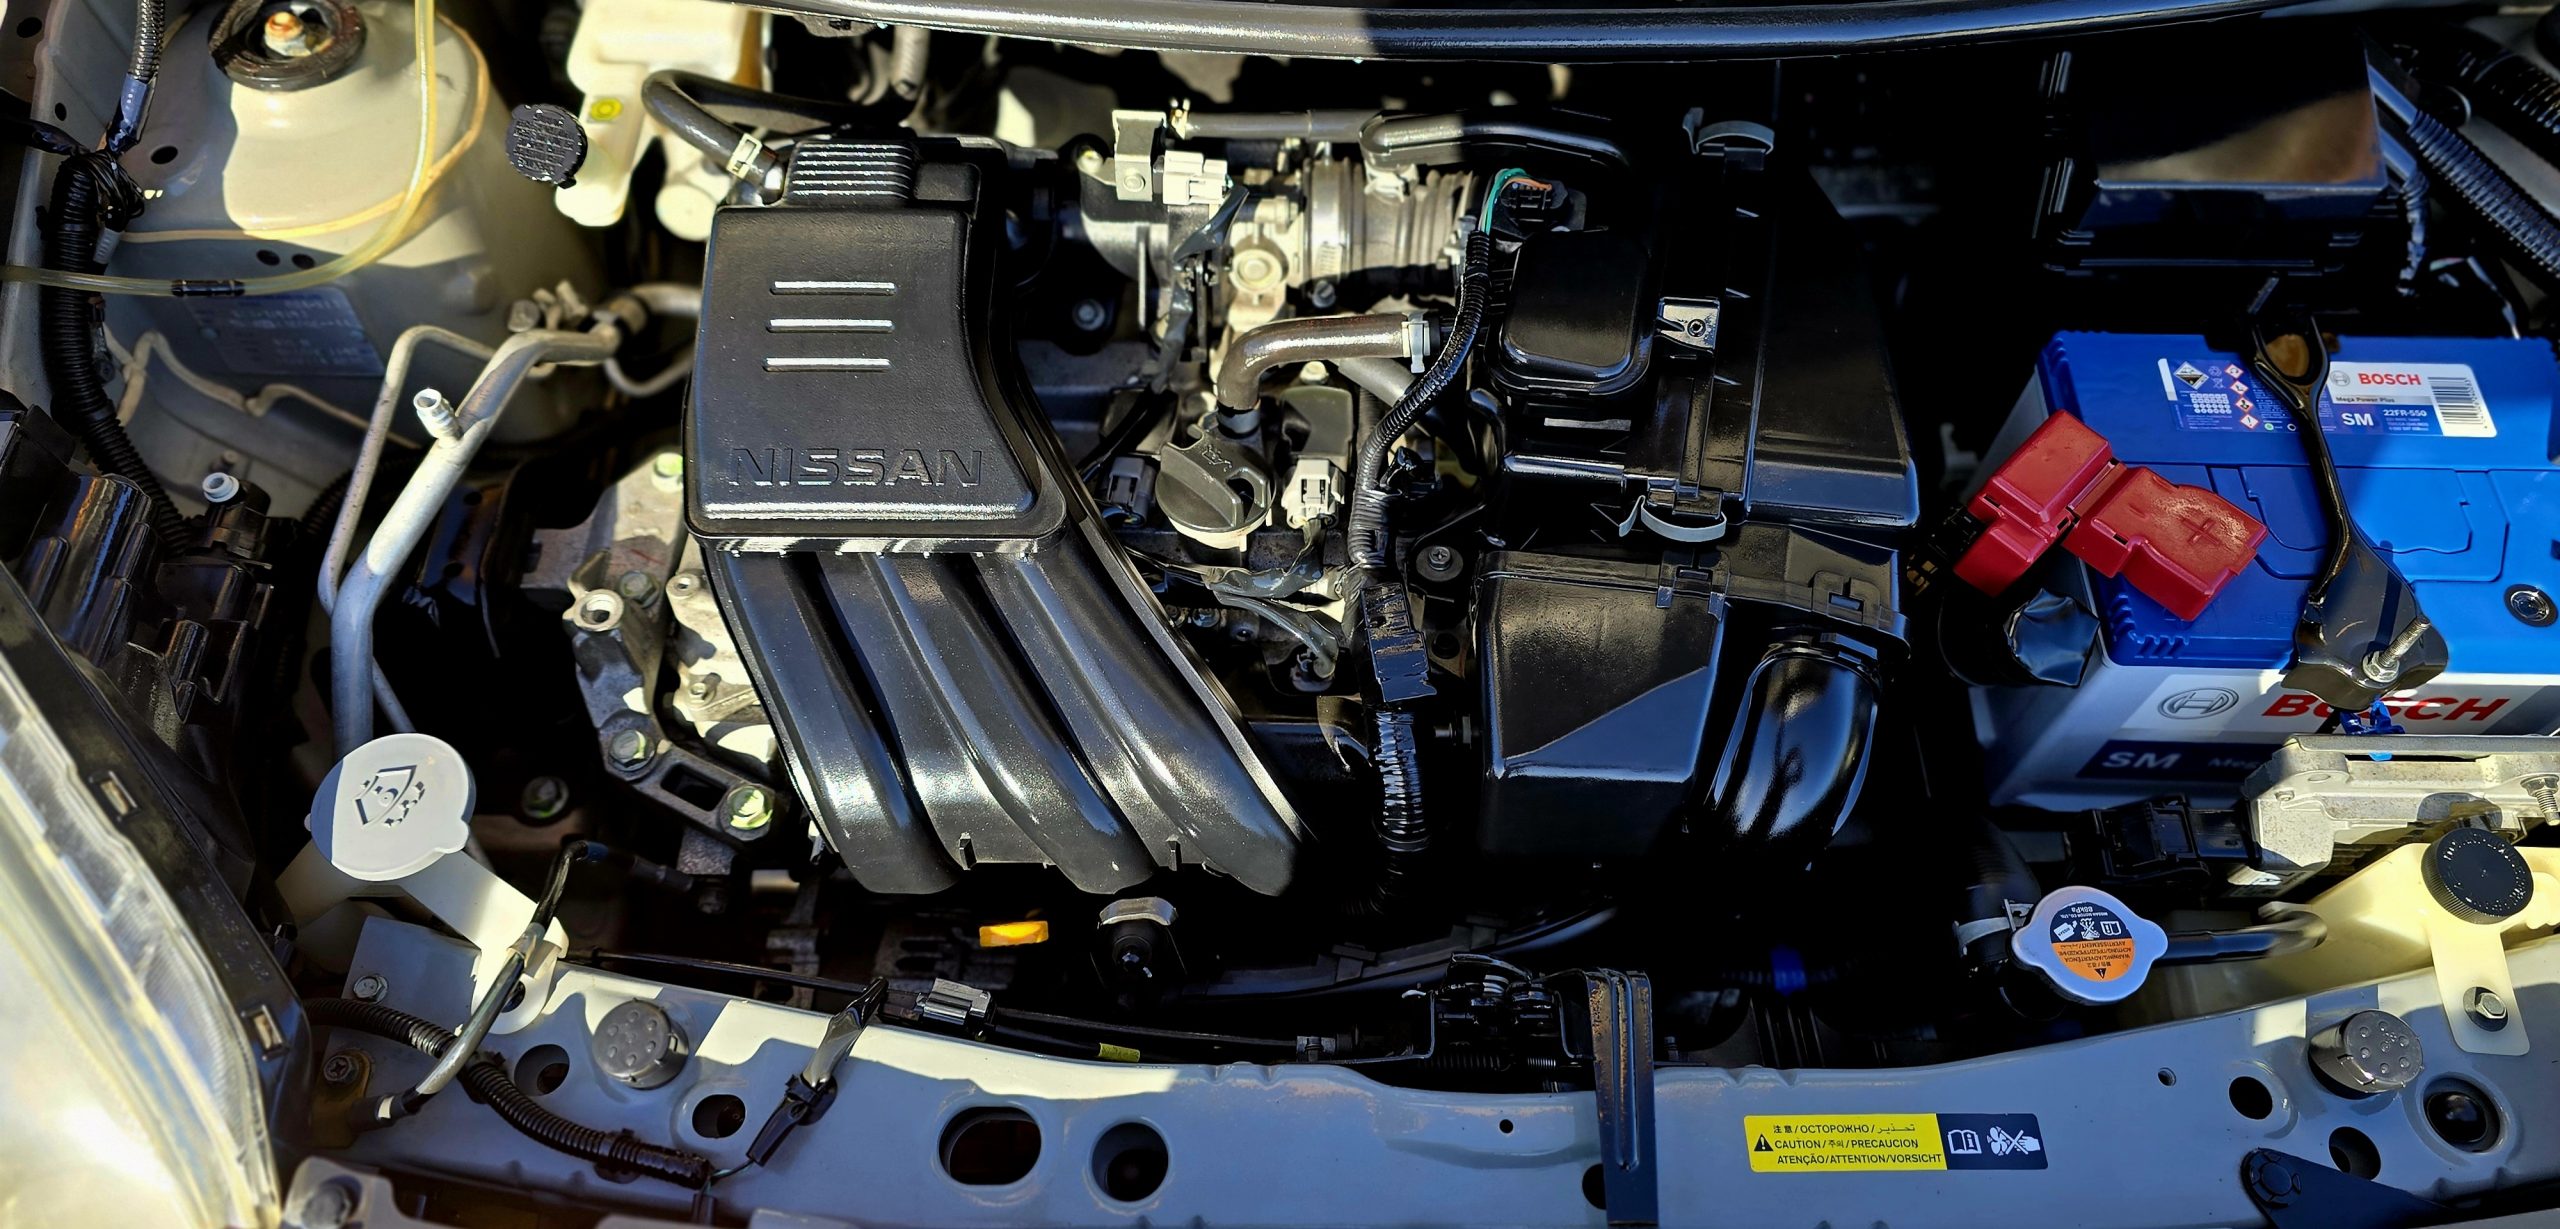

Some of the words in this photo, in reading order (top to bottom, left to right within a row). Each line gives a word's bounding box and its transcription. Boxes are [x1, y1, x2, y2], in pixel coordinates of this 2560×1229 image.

[2357, 373, 2421, 385] BOSCH
[2341, 412, 2374, 426] SM
[2383, 409, 2427, 417] 22FR-550
[729, 448, 982, 486] NISSAN
[2102, 751, 2182, 769] SM
[1774, 1139, 1821, 1149] CAUTION
